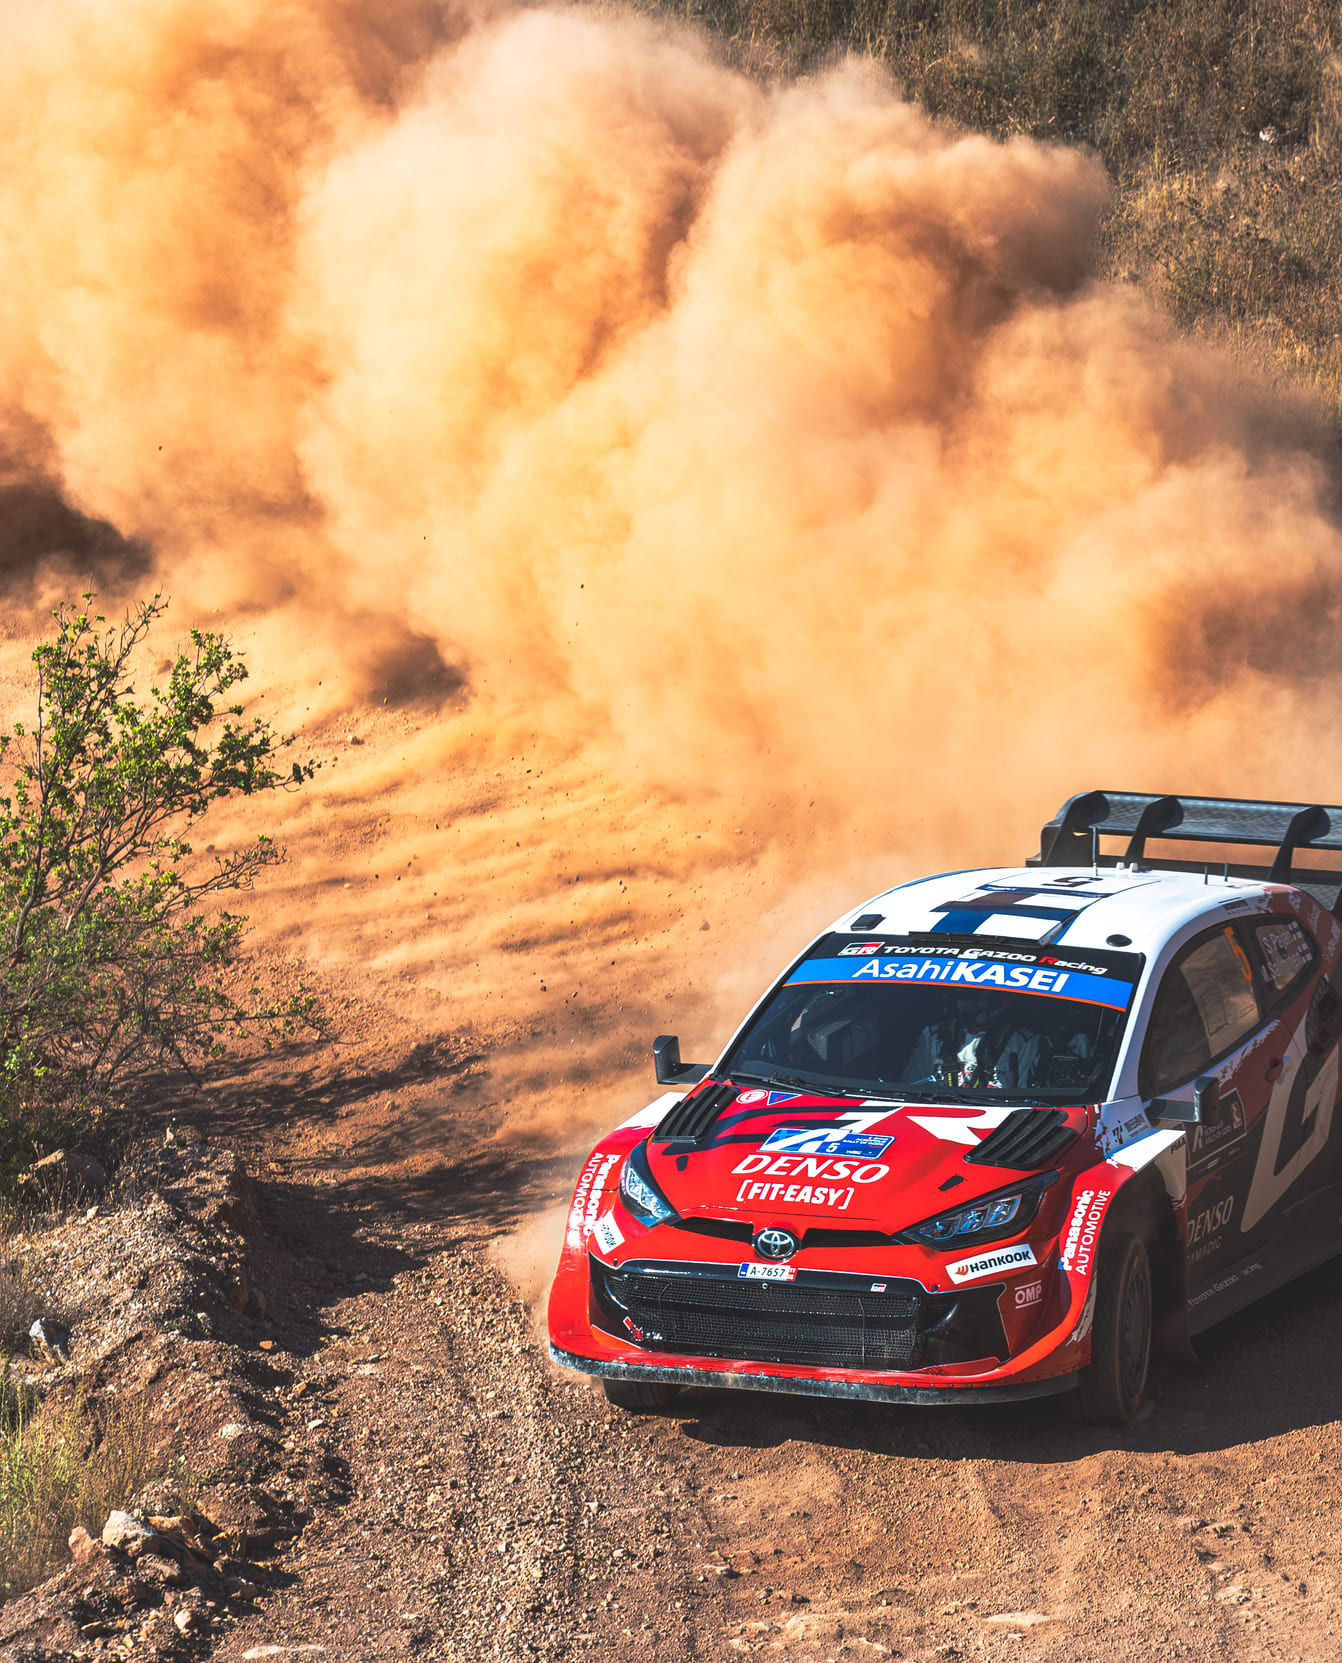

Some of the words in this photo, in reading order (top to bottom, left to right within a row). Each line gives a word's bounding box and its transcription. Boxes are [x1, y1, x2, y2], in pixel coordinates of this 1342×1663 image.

[852, 958, 1070, 993] AsahiKASEI
[883, 946, 960, 956] TOYOTA
[1039, 956, 1108, 975] Racing
[1223, 926, 1252, 982] 5
[731, 1154, 890, 1184] DENSO
[825, 1142, 840, 1153] 5
[567, 1152, 604, 1247] AUTOMOT
[583, 1154, 621, 1236] Panasonic
[1062, 1189, 1095, 1271] Panasonic
[1075, 1189, 1111, 1276] AUTOMOTIVE
[1186, 1195, 1234, 1247] DENSO
[750, 1266, 786, 1278] A-7657
[1014, 1284, 1042, 1304] OMP
